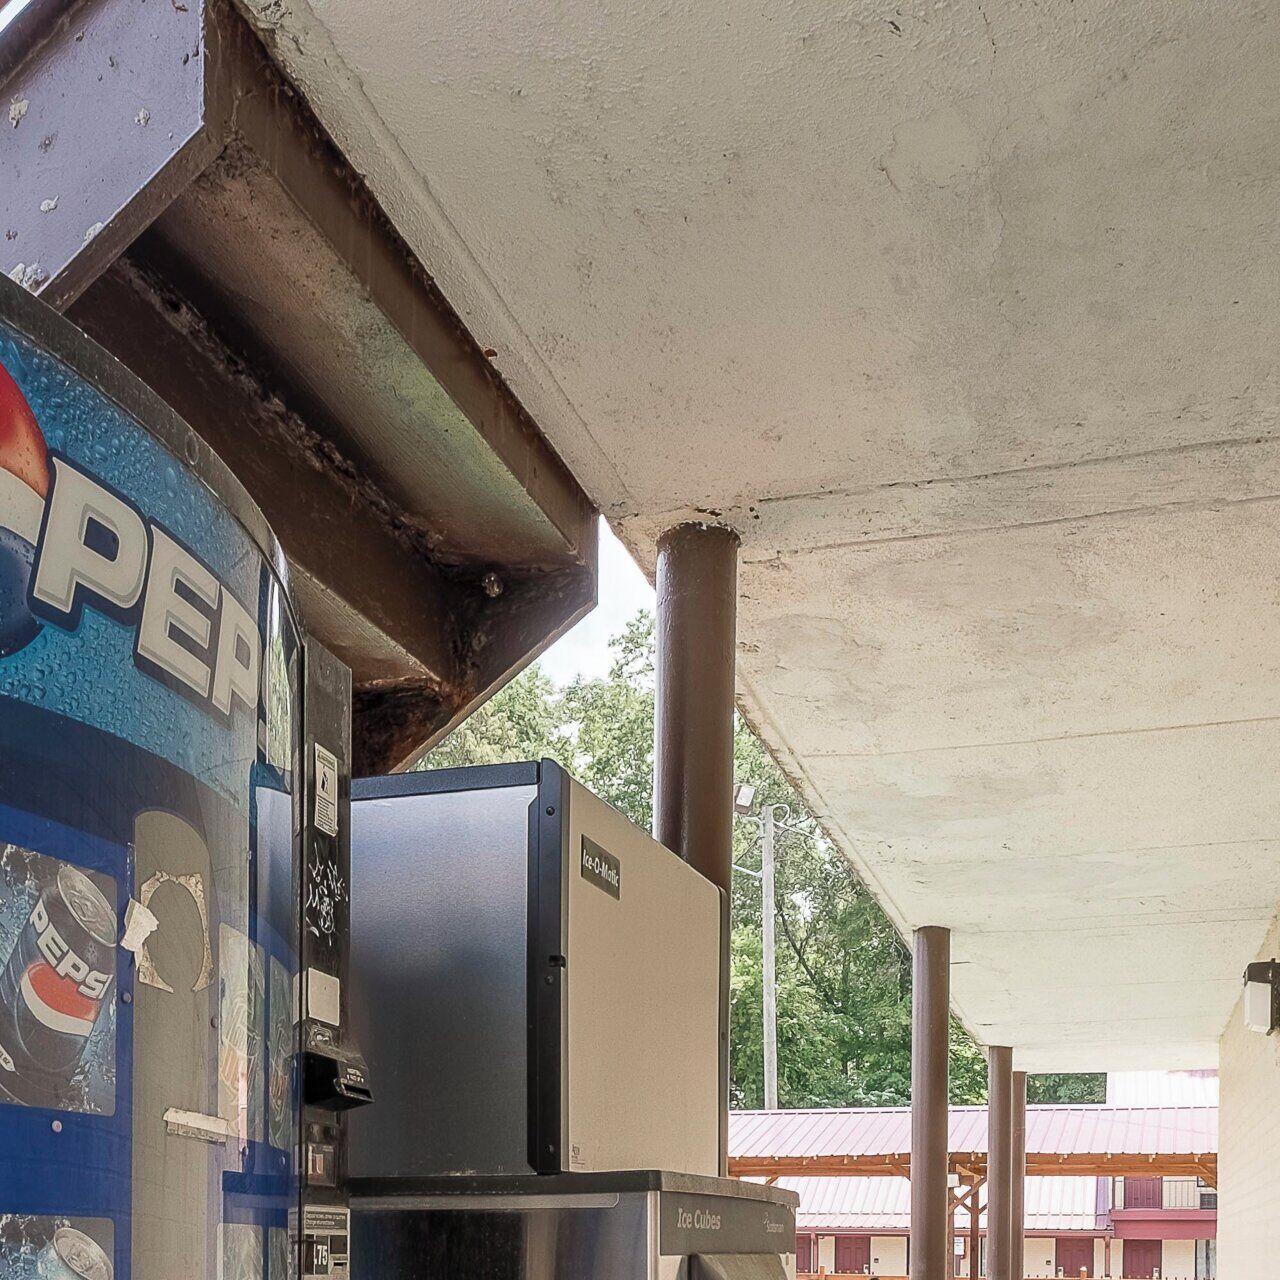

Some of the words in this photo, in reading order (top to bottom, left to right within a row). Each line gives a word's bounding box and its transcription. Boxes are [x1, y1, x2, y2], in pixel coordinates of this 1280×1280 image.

[32, 455, 266, 758] PEP
[582, 848, 619, 888] Ice-O-Matic
[30, 897, 114, 1000] PEPSI
[677, 1207, 692, 1229] Ice
[693, 1206, 721, 1230] Cubes
